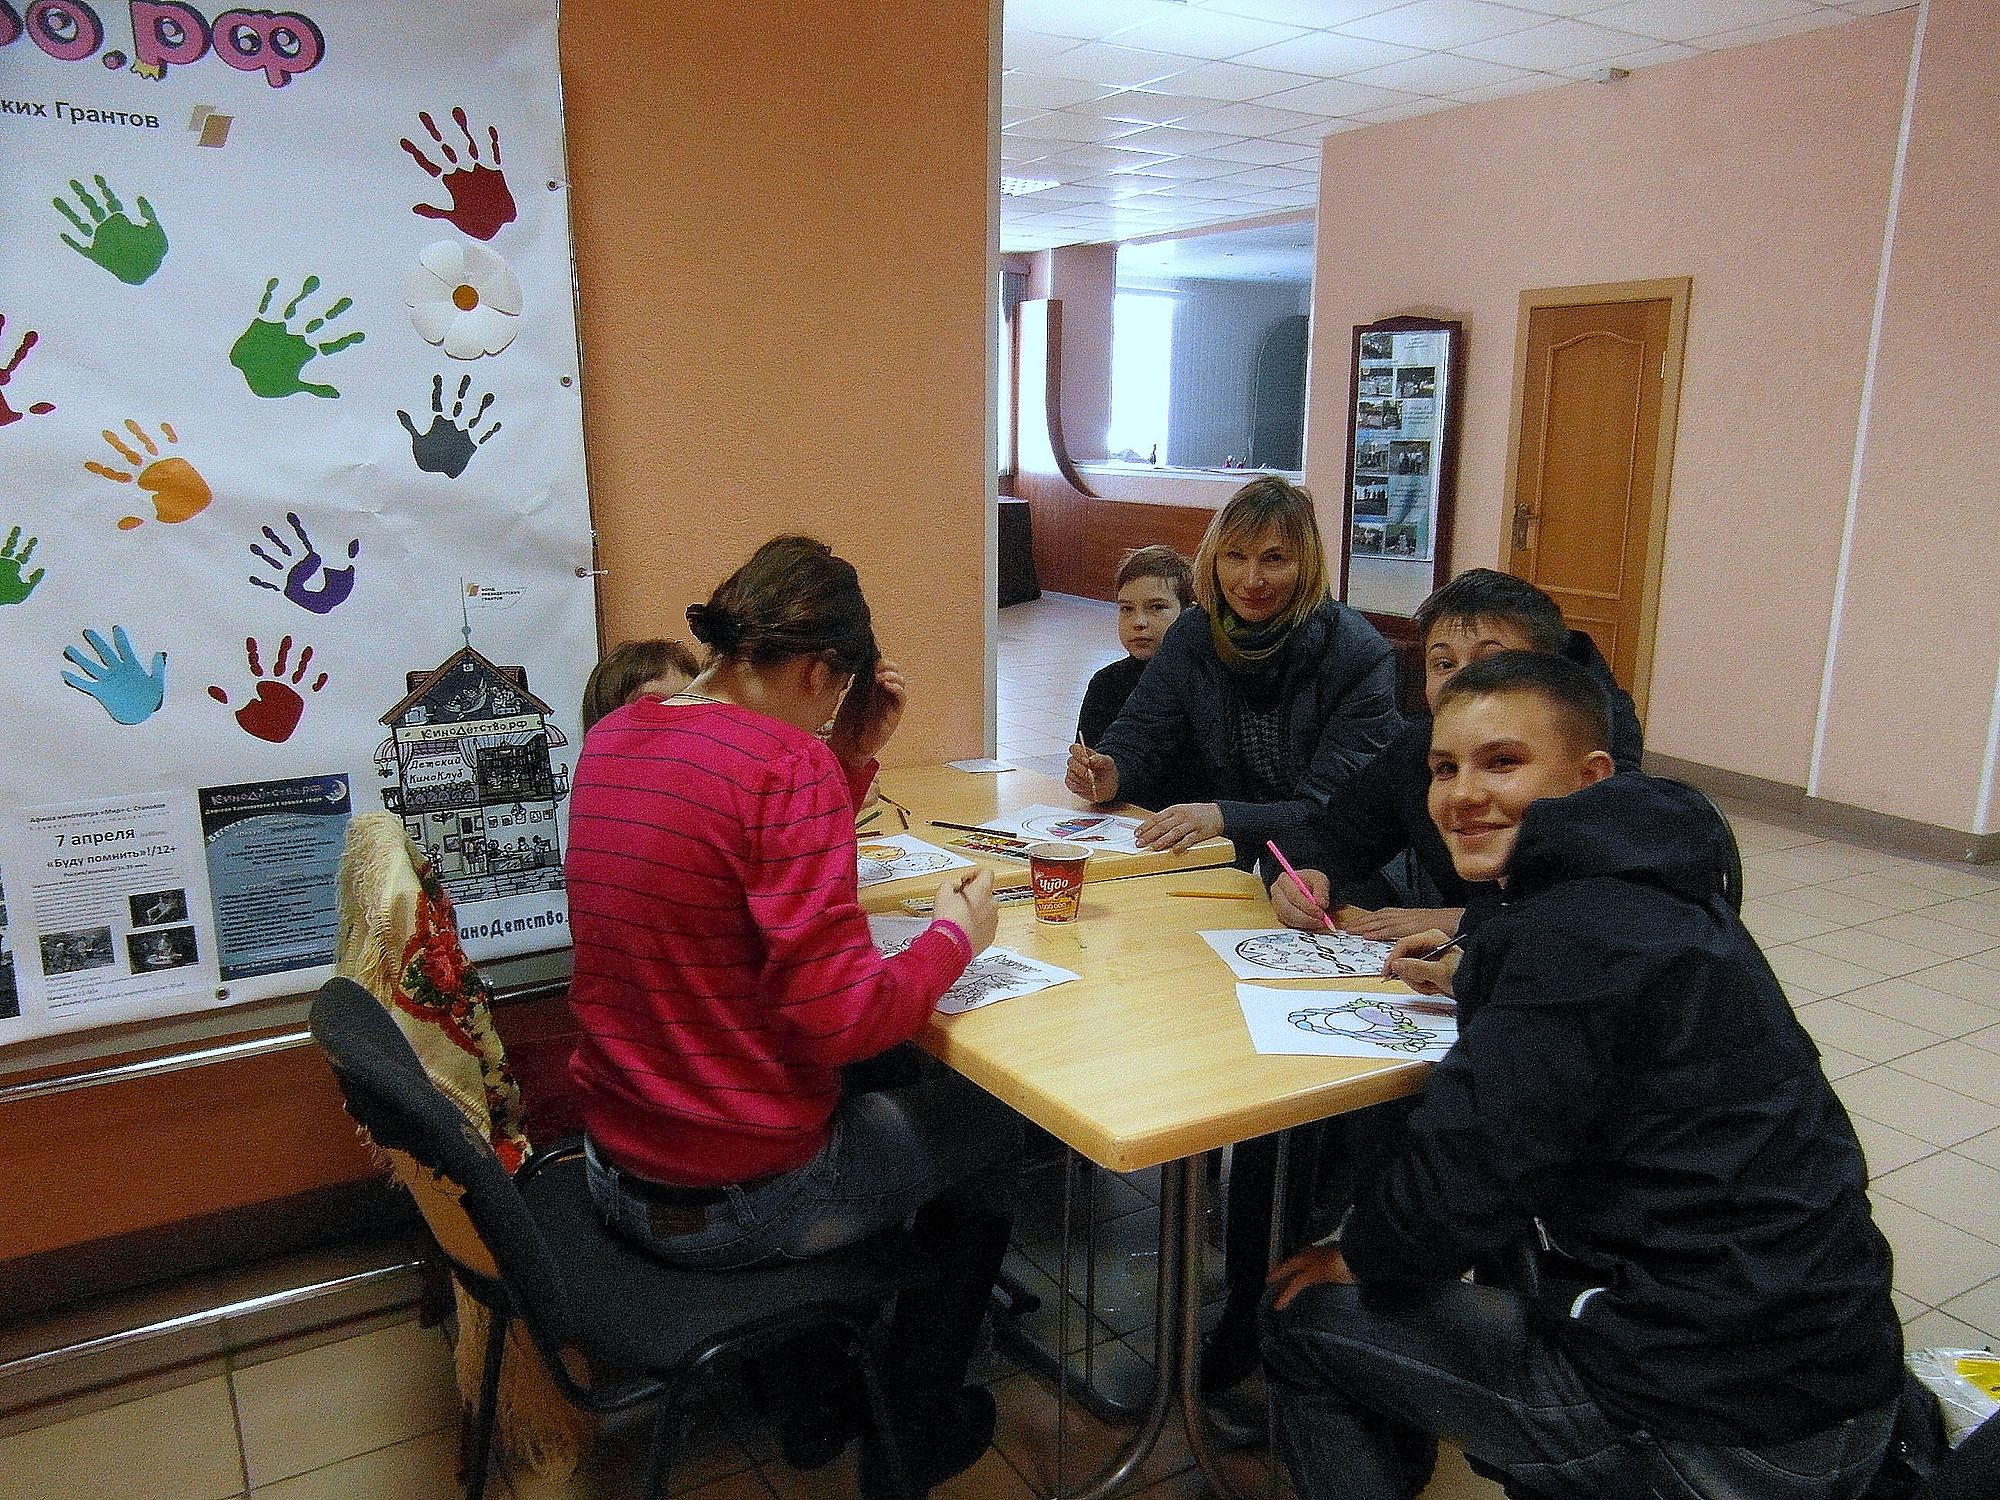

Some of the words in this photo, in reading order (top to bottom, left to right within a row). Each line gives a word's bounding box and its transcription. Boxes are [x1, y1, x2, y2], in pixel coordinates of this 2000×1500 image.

[55, 100, 160, 129] Грантов
[410, 757, 461, 770] Детский
[55, 834, 65, 848] 7
[71, 828, 135, 846] апреля
[47, 857, 84, 869] «Буду
[1040, 878, 1069, 893] Чудо
